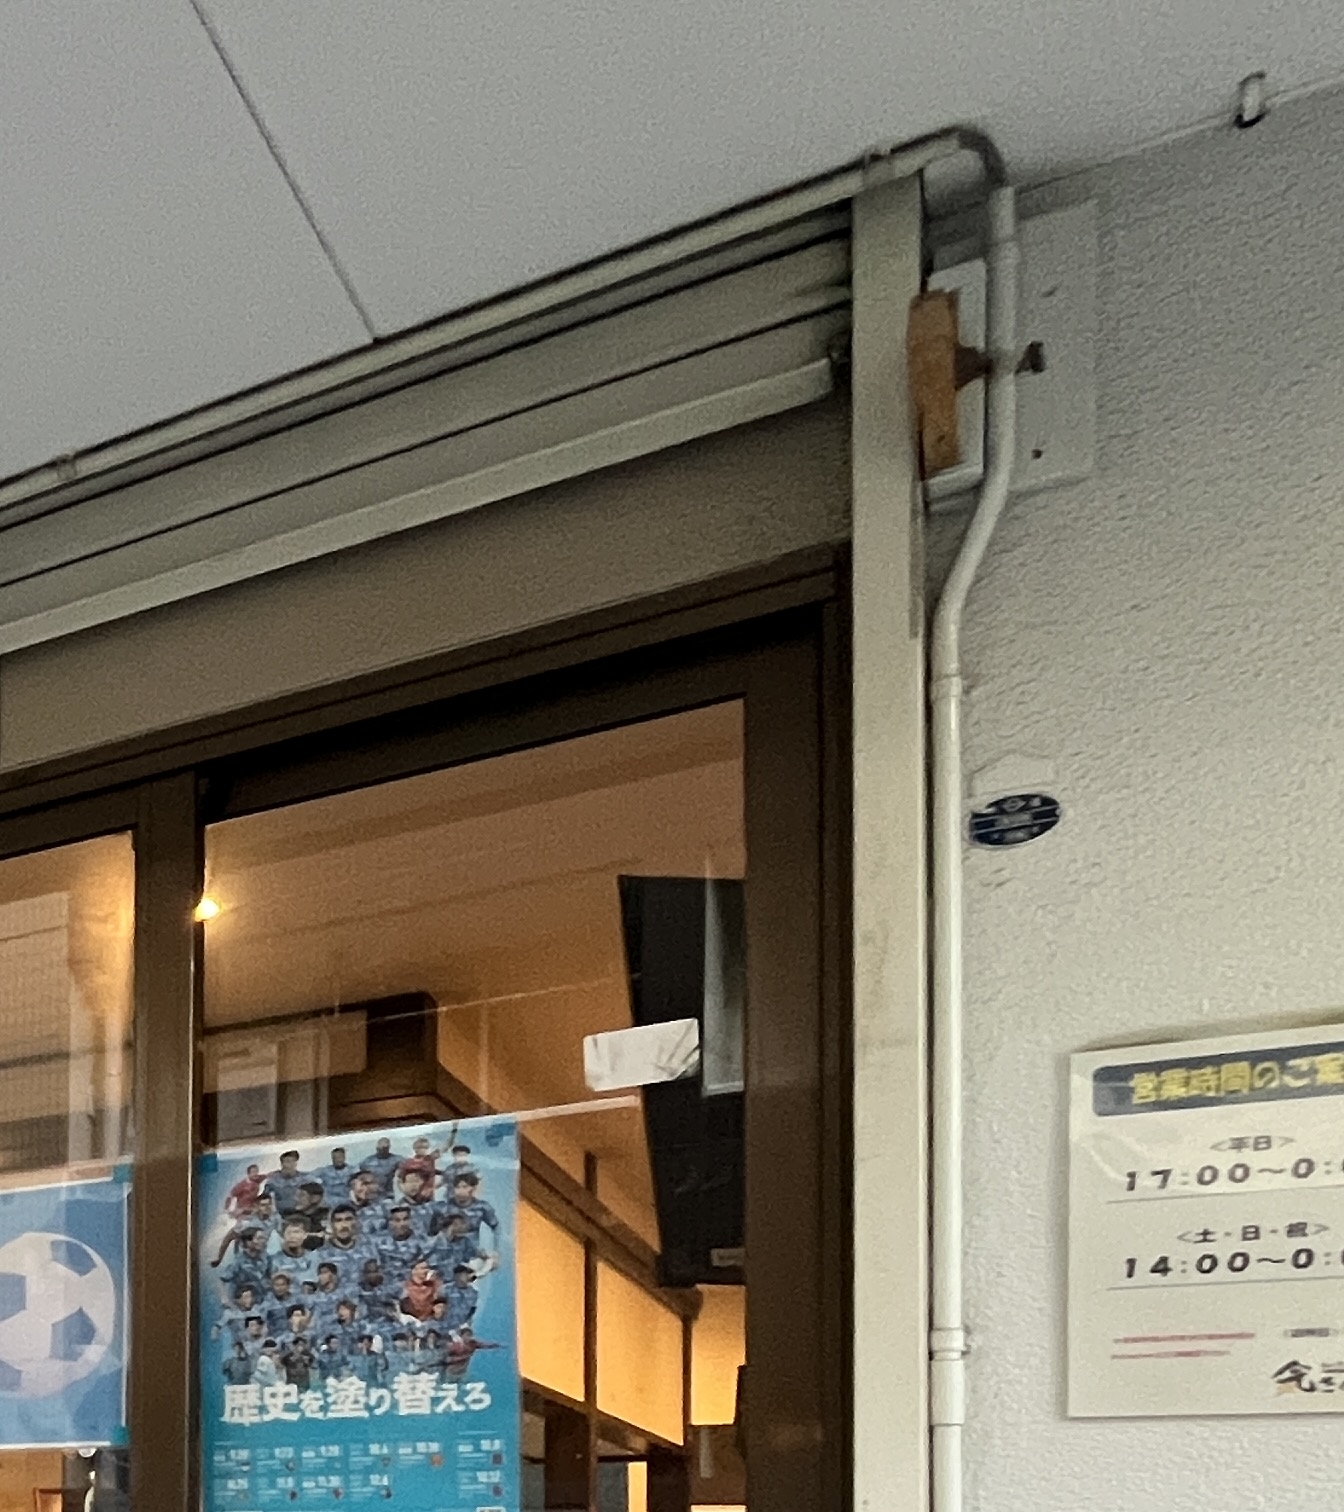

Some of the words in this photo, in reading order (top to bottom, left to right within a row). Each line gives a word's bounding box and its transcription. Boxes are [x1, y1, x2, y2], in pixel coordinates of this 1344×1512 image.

[220, 1372, 493, 1427] 歴史を塗り替えろ
